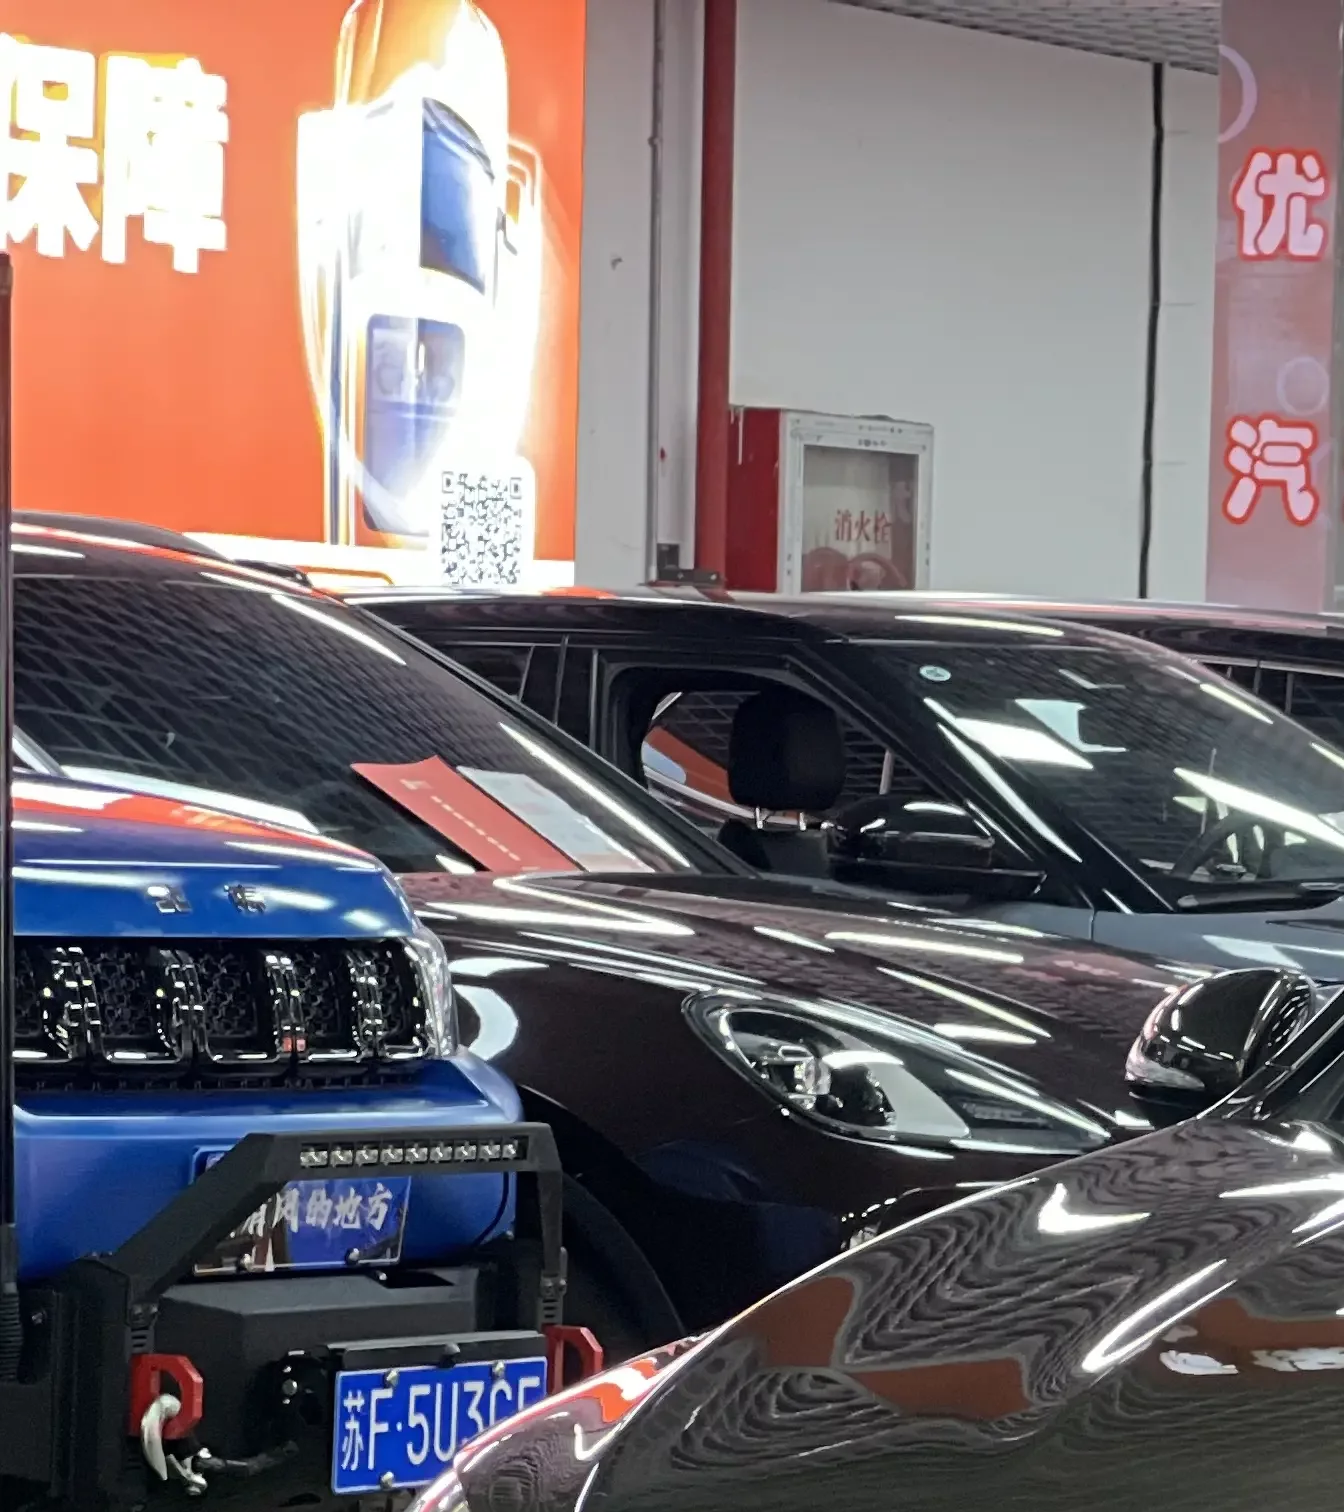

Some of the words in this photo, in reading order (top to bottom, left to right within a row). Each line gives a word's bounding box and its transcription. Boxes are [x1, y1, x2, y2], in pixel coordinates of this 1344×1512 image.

[0, 32, 229, 274] 保障
[834, 508, 892, 544] 消火栓
